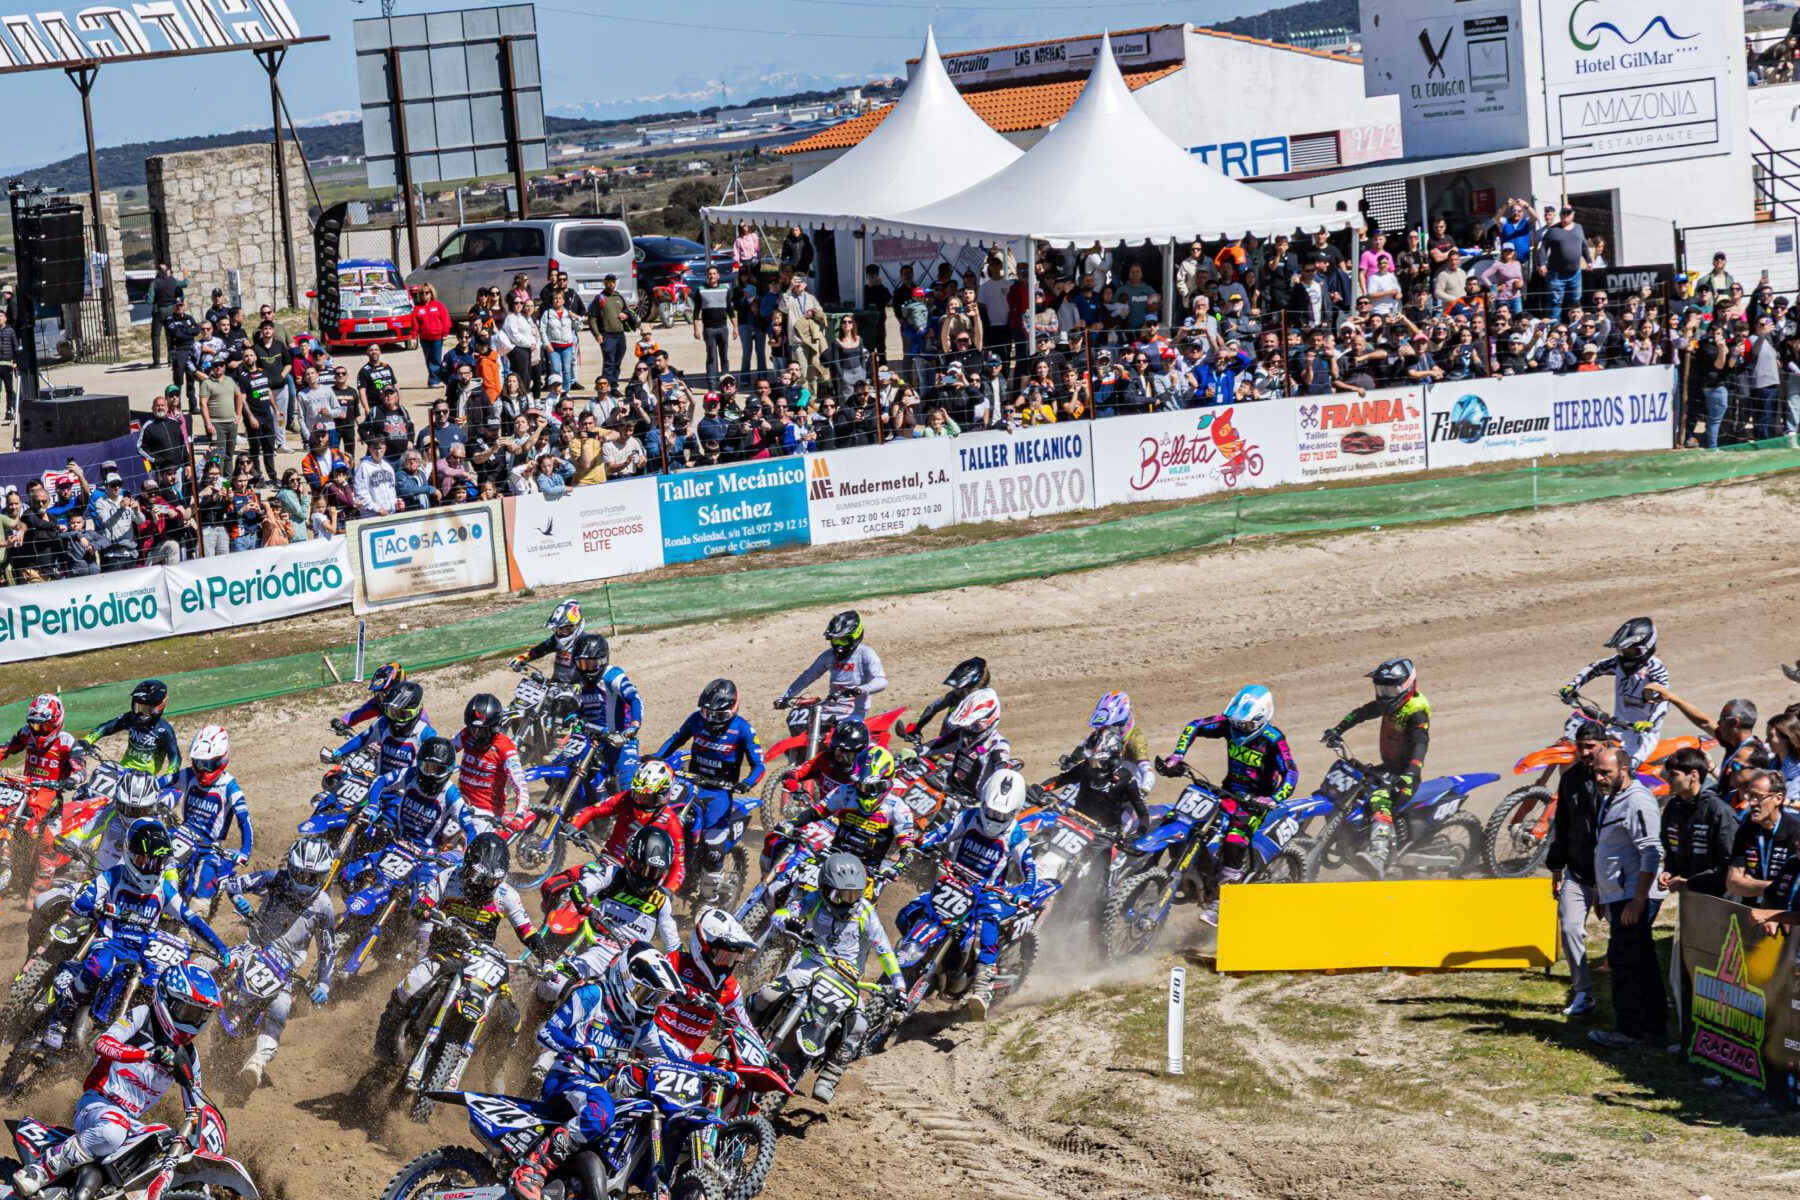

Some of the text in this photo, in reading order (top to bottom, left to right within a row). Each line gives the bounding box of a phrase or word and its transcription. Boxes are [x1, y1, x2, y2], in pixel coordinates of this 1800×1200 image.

[947, 56, 989, 75] Circuito
[1014, 45, 1066, 66] LAS ARENAS
[1575, 51, 1674, 75] Hotel GilMar
[1411, 84, 1422, 100] EL
[1581, 89, 1698, 127] AMAZONIA
[1321, 398, 1405, 430] FRANRA
[1554, 392, 1668, 432] HIERROS DIAZ
[1305, 431, 1328, 440] Taller
[1390, 432, 1422, 442] Pintura
[1391, 422, 1420, 432] Chapa
[959, 444, 1009, 472] TALLER
[1130, 433, 1217, 491] Bellota
[659, 466, 805, 503] Taller Mecánico
[839, 469, 950, 497] Madermetal, S.A.
[958, 467, 1085, 519] MARROYO
[698, 499, 773, 527] Sánchez
[835, 492, 927, 511] SUMINISTROS INDUSTRIALES
[821, 504, 942, 528] TEL. 927 22 00 14 927 22 10 20
[582, 523, 644, 540] MOTOCROSS
[664, 533, 690, 548] Ronda
[691, 529, 728, 546] Soledad,
[729, 528, 741, 539] s/n
[774, 521, 784, 532] 29
[786, 519, 796, 531] 12
[798, 517, 808, 529] 15
[527, 544, 538, 553] LOS
[584, 541, 612, 553] ELITE
[703, 537, 772, 556] Casar de Cáceres
[299, 556, 339, 570] Extremadura
[115, 586, 156, 600] Extremadura
[180, 561, 343, 613] el Periódico
[22, 591, 157, 639] Periódico
[336, 780, 368, 801] 709
[186, 795, 219, 814] YAMAHA
[403, 797, 437, 821] YAMAHA
[1176, 790, 1214, 820] 150
[1050, 827, 1090, 854] 115
[1275, 816, 1299, 846] 150
[379, 853, 415, 875] 128
[963, 839, 1000, 864] YAMAHA
[932, 883, 974, 916] 276
[143, 940, 189, 966] 385
[1172, 975, 1183, 1005] UFO
[654, 1069, 700, 1098] 214
[470, 1098, 530, 1126] 214
